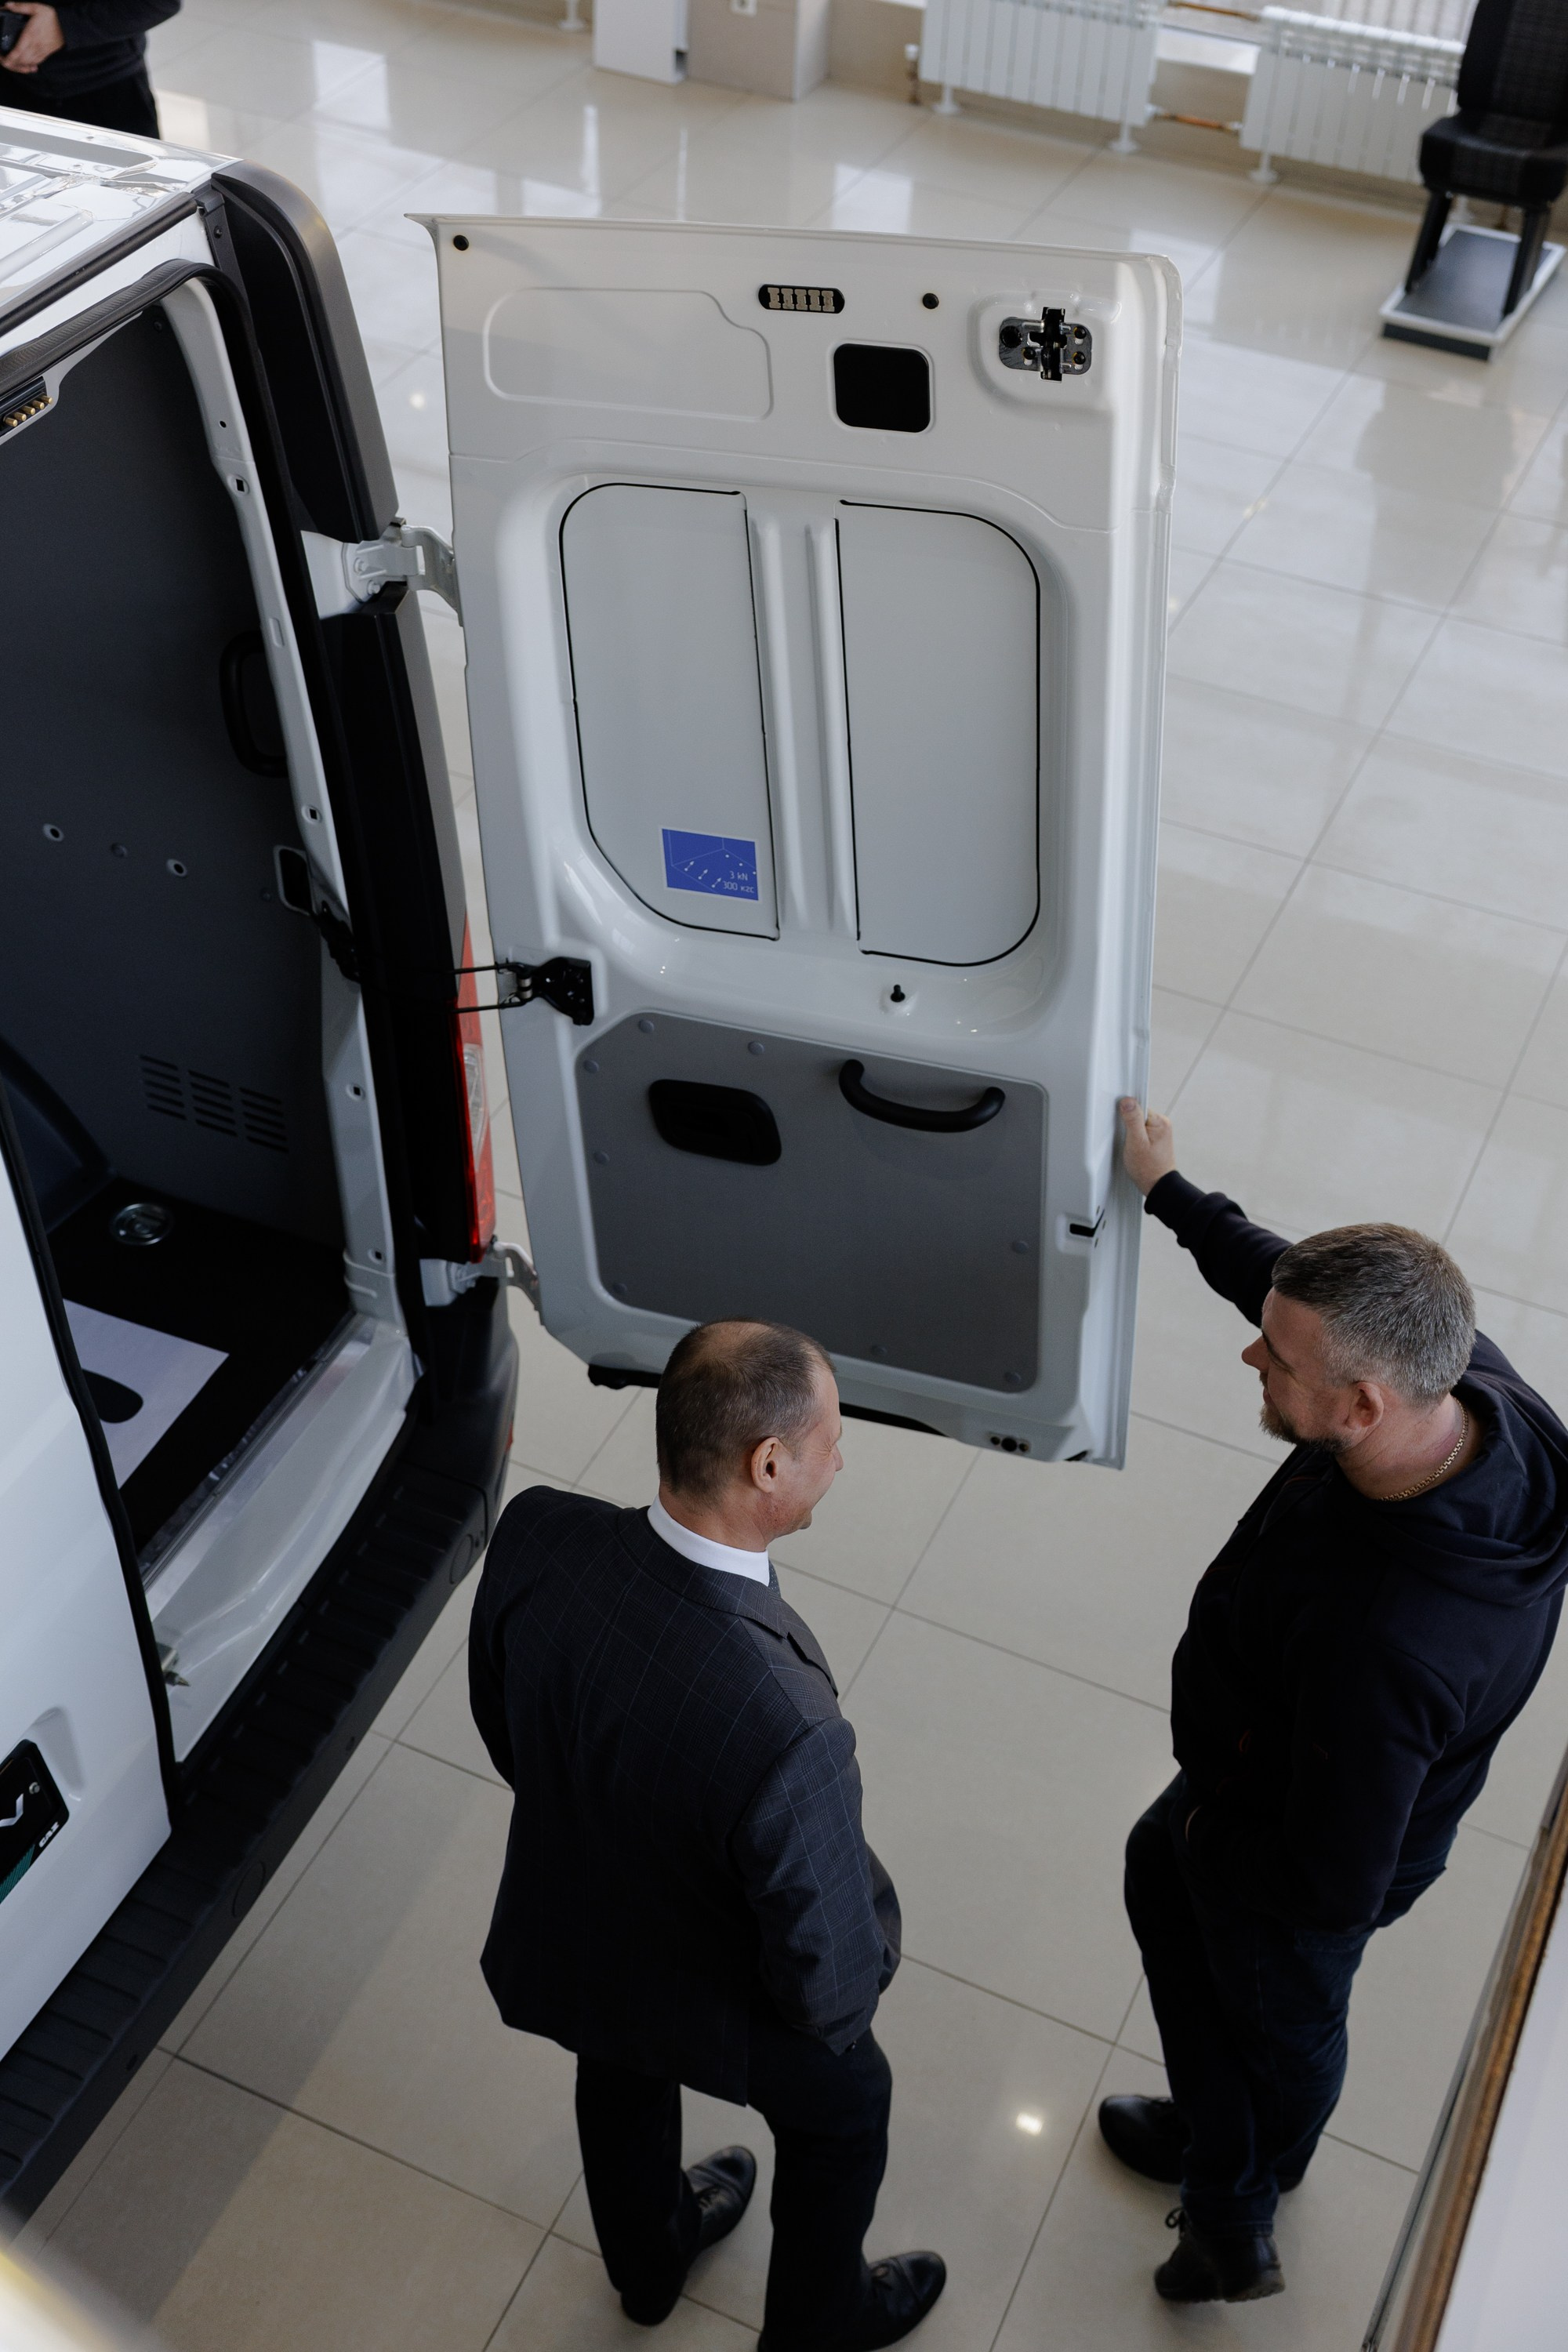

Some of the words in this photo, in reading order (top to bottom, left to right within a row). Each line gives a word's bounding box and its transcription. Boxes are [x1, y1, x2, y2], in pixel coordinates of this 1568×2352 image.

[729, 870, 735, 879] 3
[737, 872, 748, 881] kN
[722, 880, 739, 891] 300
